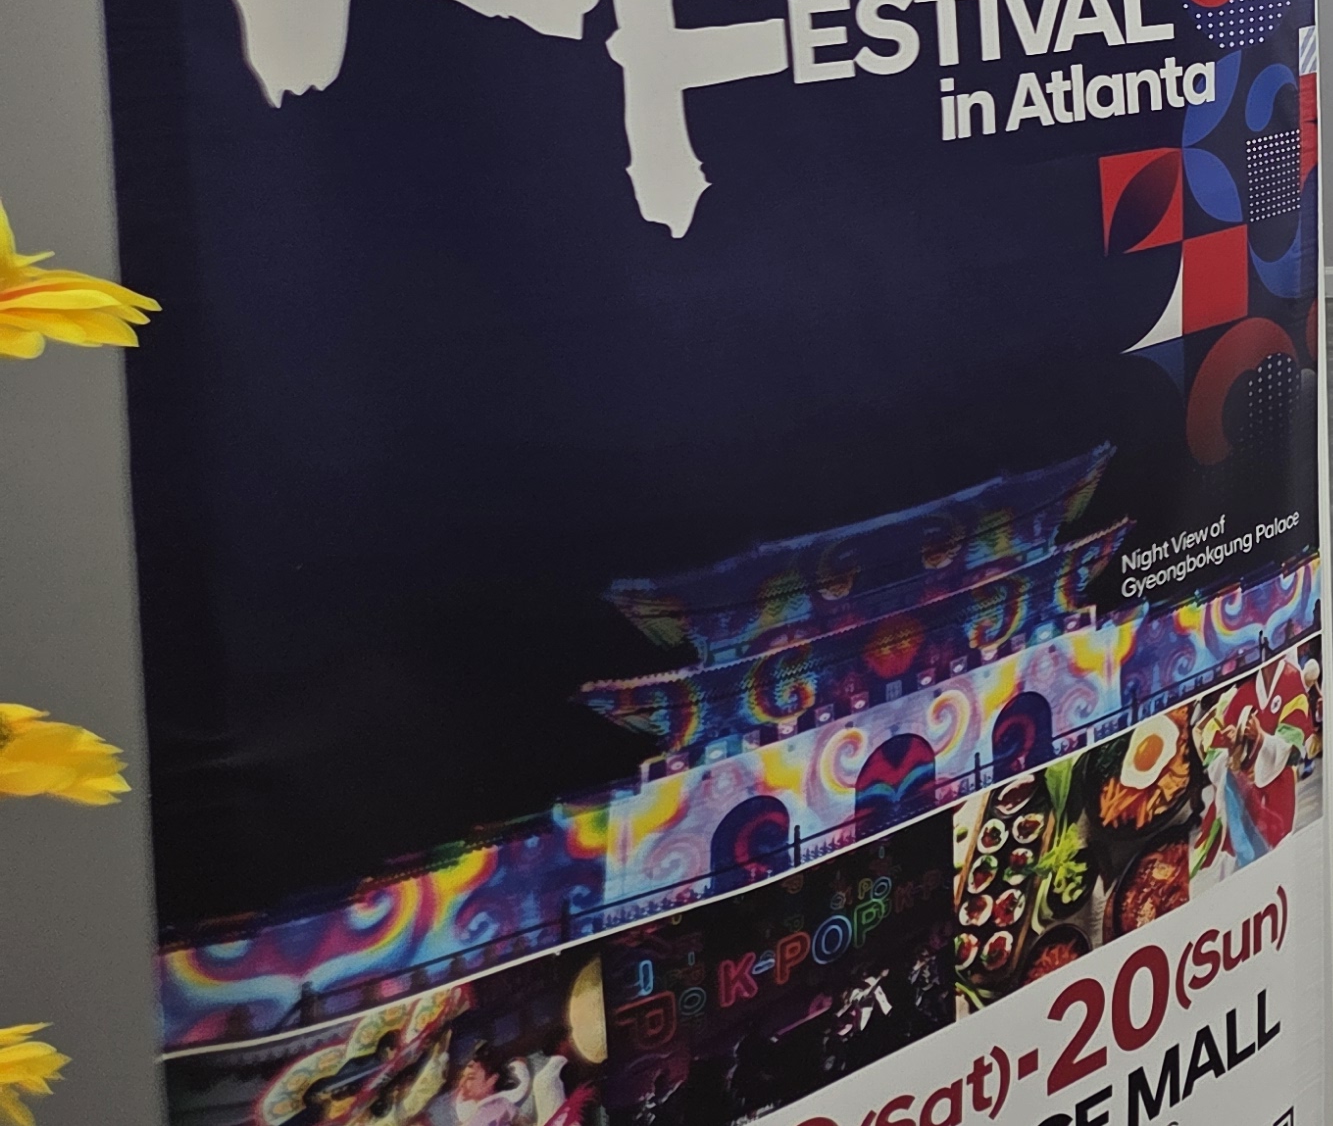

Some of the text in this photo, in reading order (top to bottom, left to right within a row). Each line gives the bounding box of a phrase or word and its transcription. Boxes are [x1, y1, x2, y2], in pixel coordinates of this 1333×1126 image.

[939, 59, 1217, 141] in Atlanta
[1120, 514, 1226, 574] Night View of
[1120, 511, 1300, 598] Gyeongbokgung Palace
[717, 897, 889, 1009] K-POP
[1128, 988, 1281, 1126] MALL
